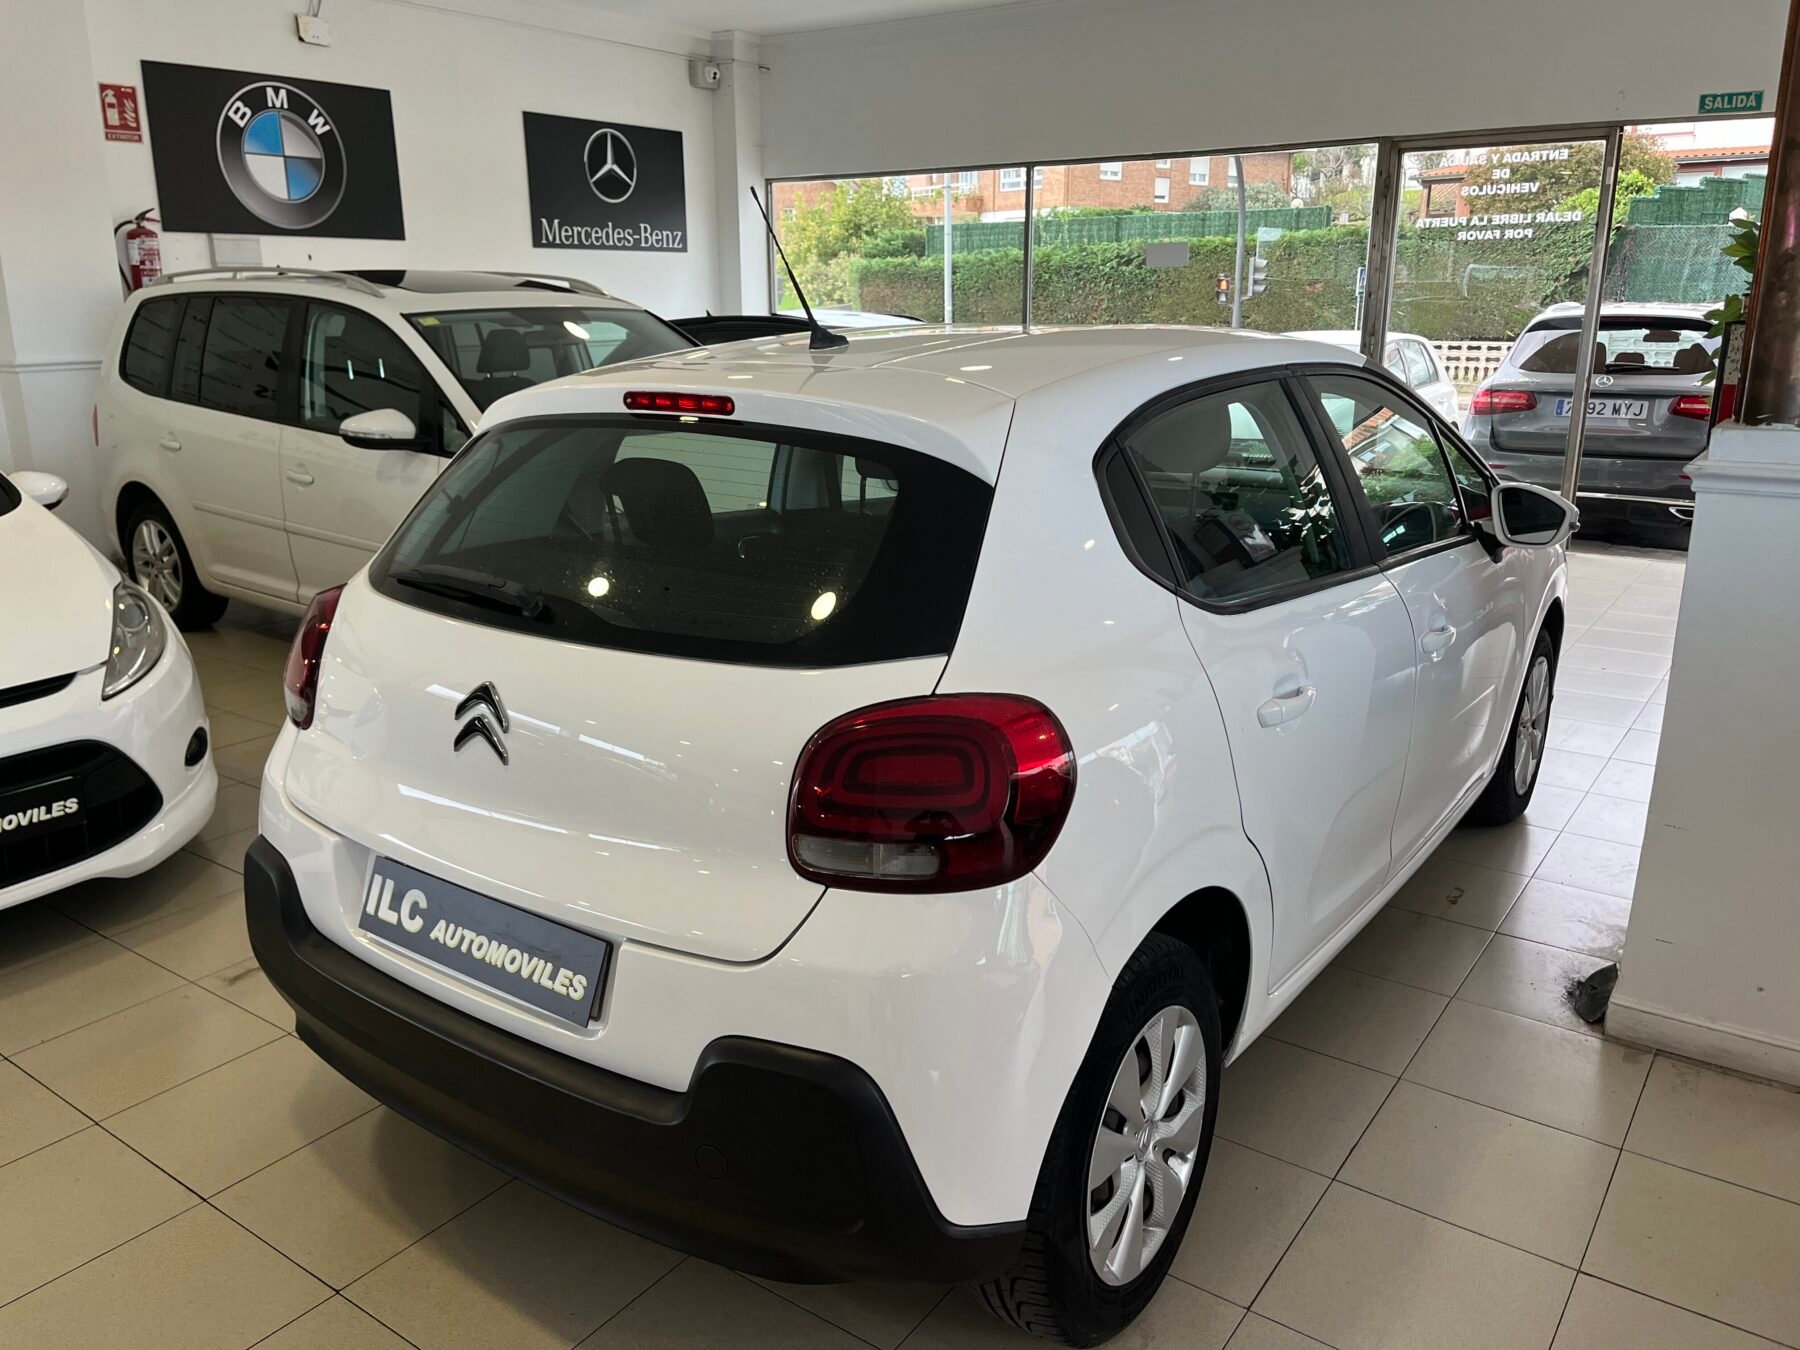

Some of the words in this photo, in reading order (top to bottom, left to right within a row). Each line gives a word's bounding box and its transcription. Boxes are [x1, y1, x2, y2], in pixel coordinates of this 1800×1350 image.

[227, 86, 331, 136] BMW
[1703, 94, 1757, 110] SALIDA
[540, 217, 683, 249] Mercedes-Benz
[1564, 400, 1605, 416] 792
[1611, 402, 1645, 417] MYJ
[0, 797, 79, 833] OVILES
[365, 873, 428, 934] ILC
[429, 919, 588, 1001] AUTOMOVILES
